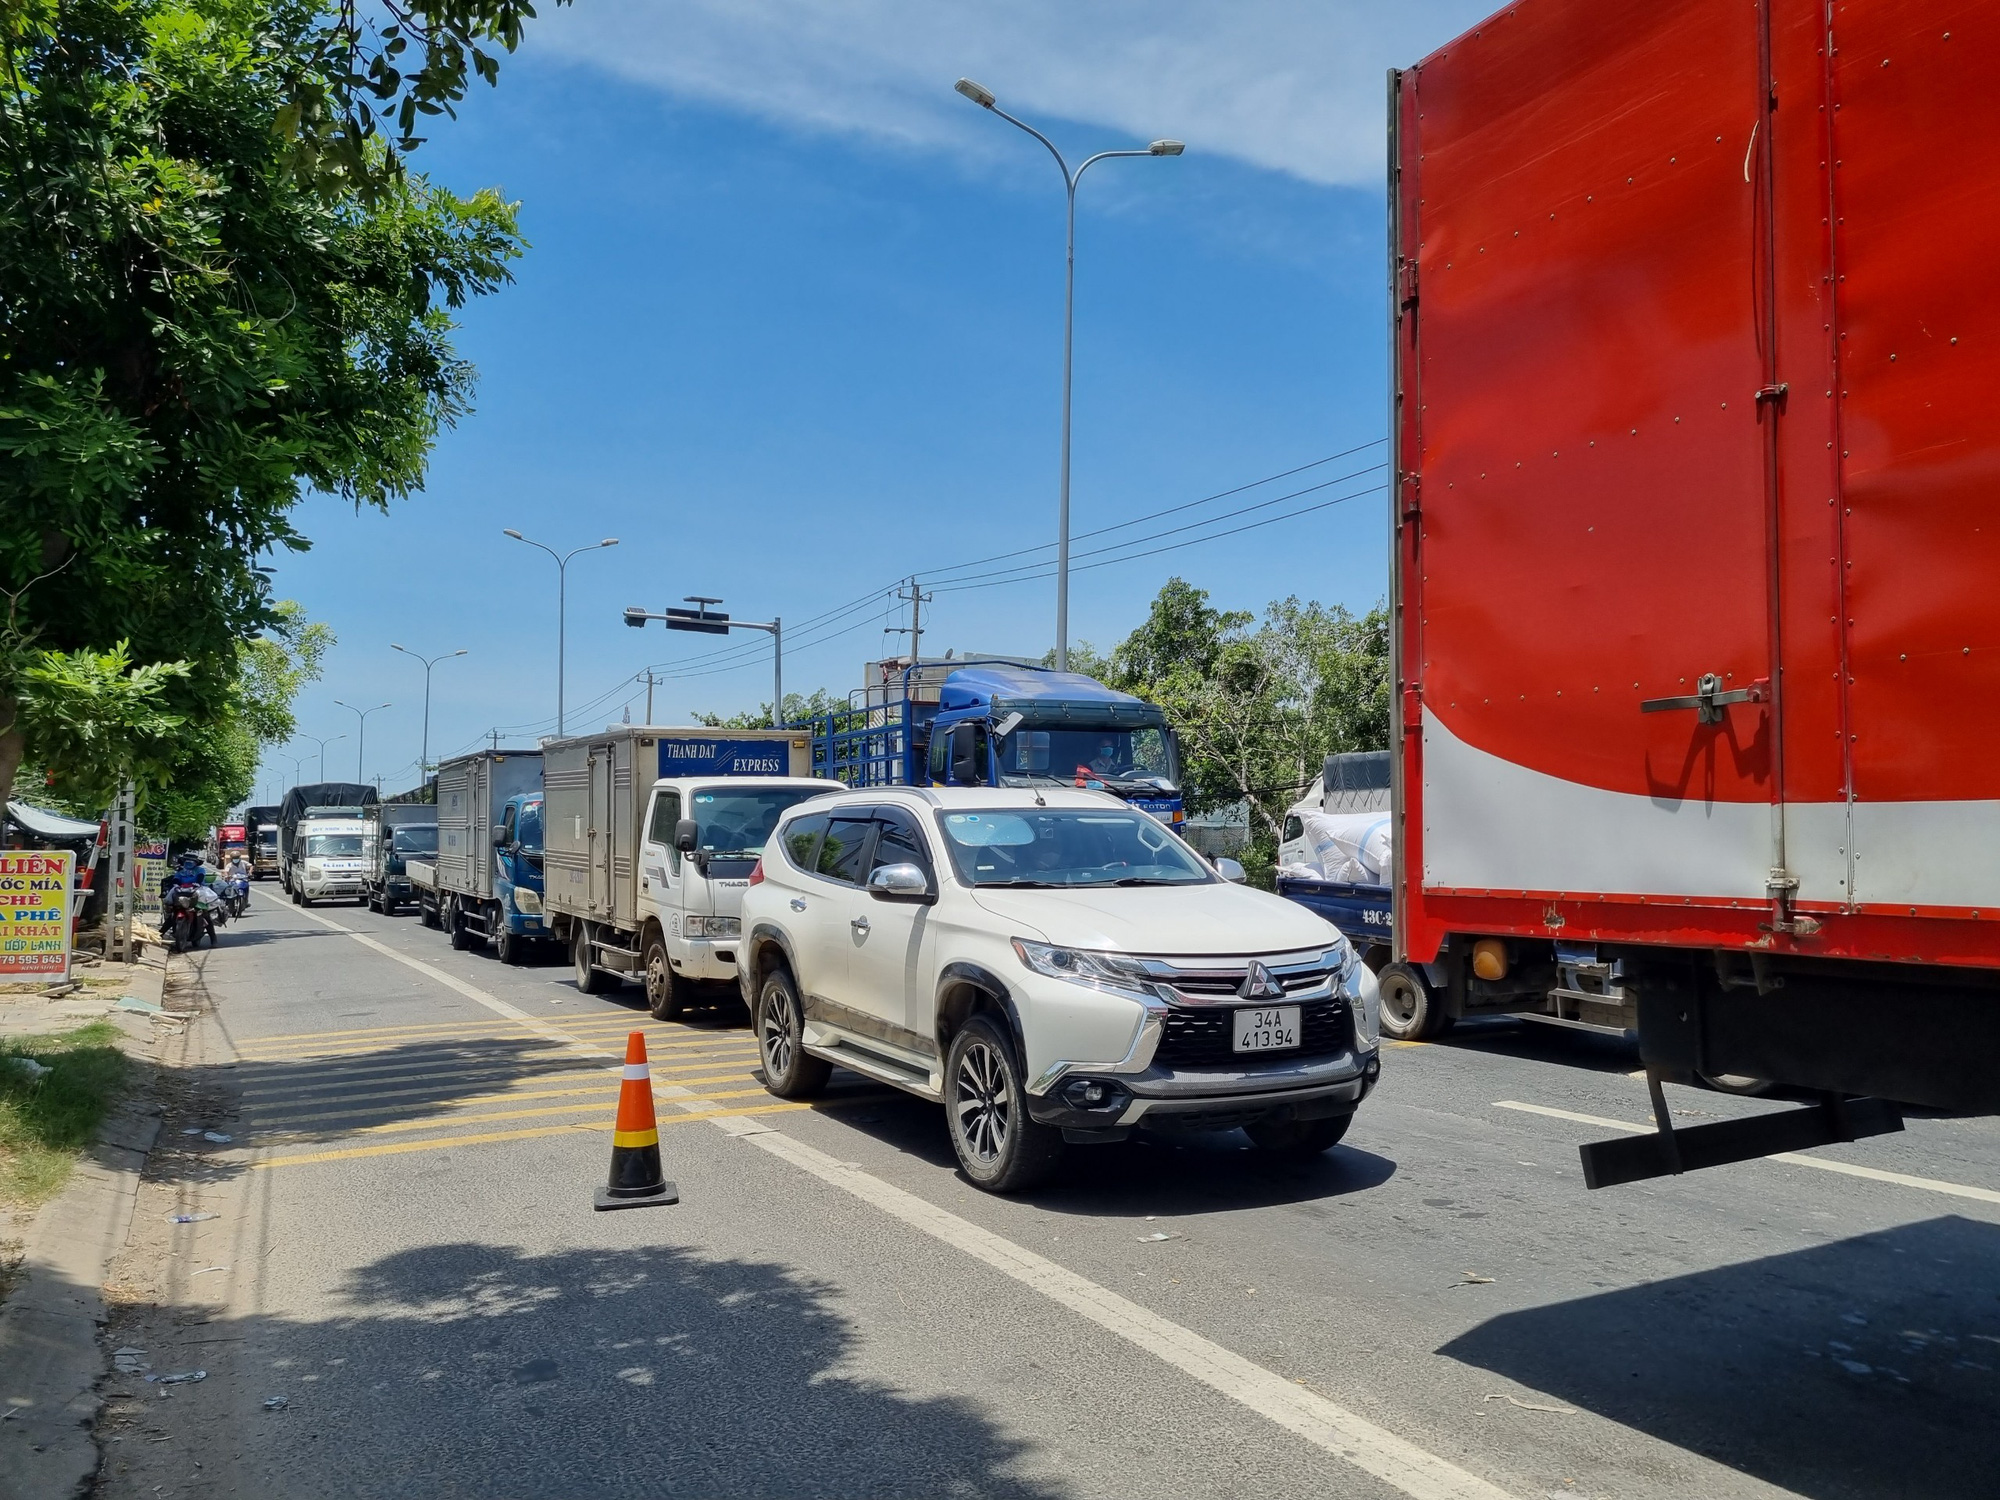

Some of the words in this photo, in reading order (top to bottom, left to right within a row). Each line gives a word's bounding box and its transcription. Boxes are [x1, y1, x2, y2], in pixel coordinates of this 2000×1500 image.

[667, 743, 697, 759] THANH
[699, 744, 716, 759] DAT
[733, 758, 780, 772] EXPRESS
[0, 853, 65, 876] LIÊN
[30, 878, 63, 891] MÍA
[0, 893, 43, 906] CHÈ
[14, 908, 62, 921] PHÊ
[14, 923, 62, 936] KHÁT
[31, 940, 61, 952] LẠNH
[18, 955, 39, 964] 595
[42, 955, 62, 963] 645
[1254, 1010, 1282, 1029] 34A
[1241, 1029, 1293, 1048] 413.94
